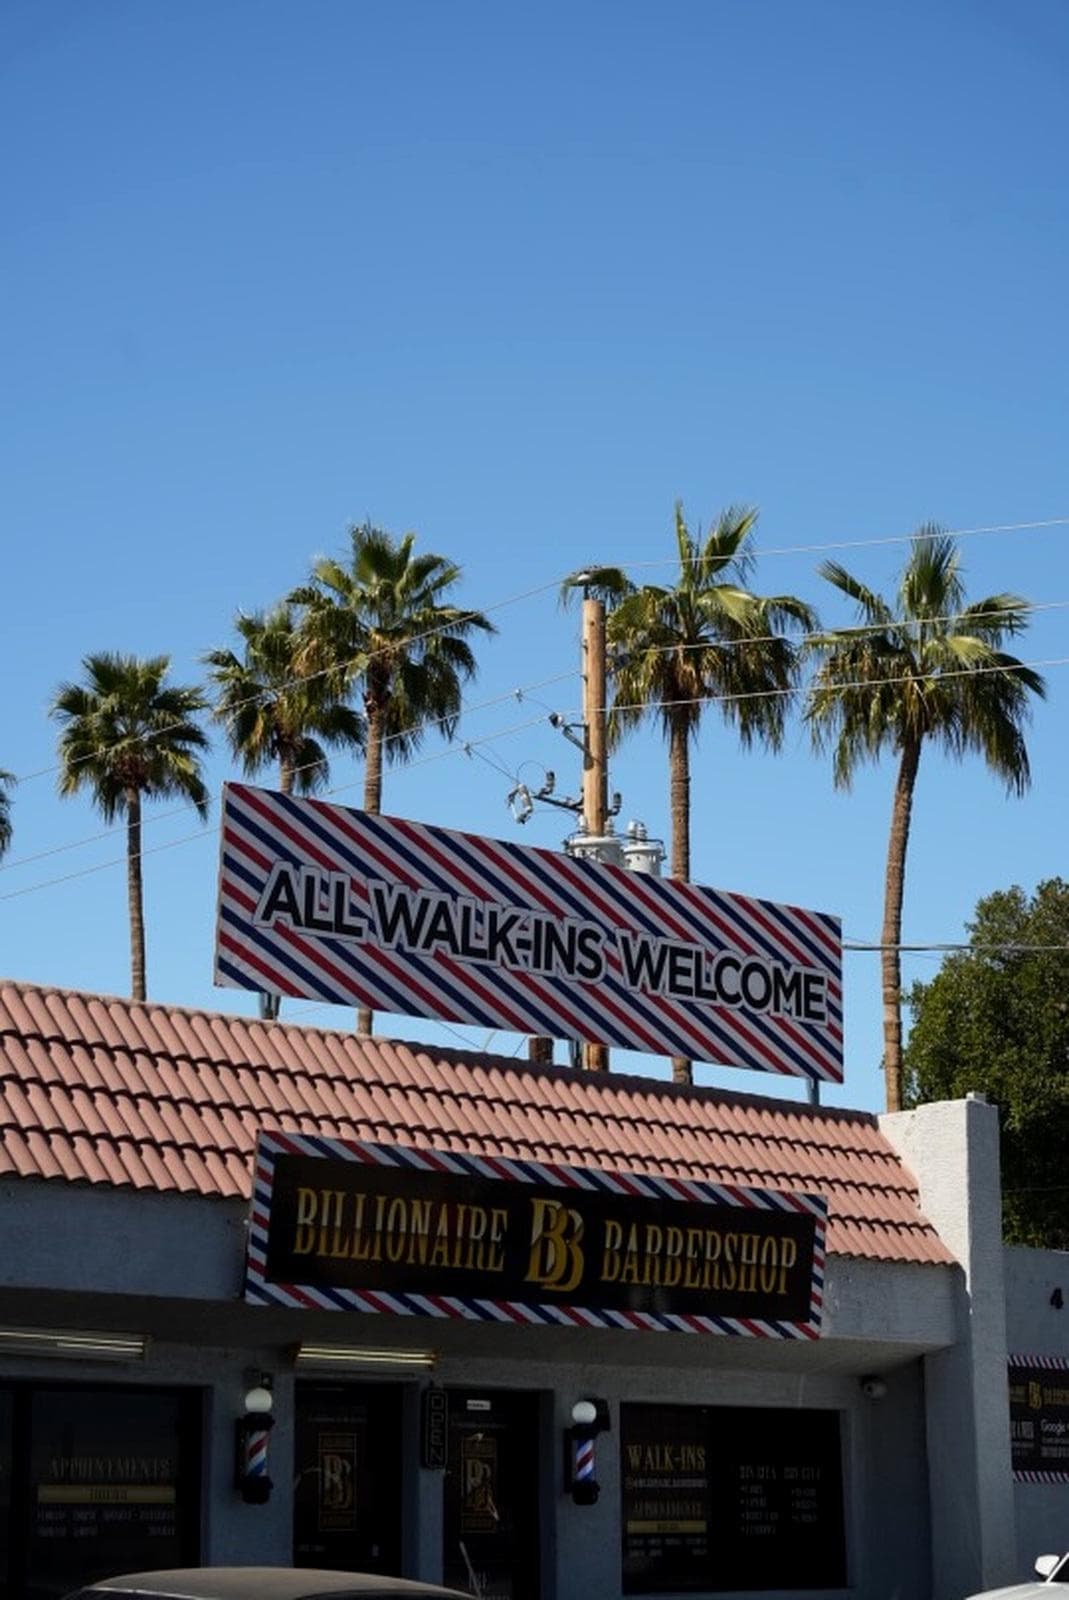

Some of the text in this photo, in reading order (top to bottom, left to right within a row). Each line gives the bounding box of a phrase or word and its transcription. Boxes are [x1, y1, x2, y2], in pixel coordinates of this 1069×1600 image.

[258, 865, 829, 1024] ALL WALK-INS WELCOME
[292, 1186, 509, 1273] BILLIONAIRE
[599, 1218, 798, 1296] BARBERSHOP
[625, 1444, 706, 1471] WALK-INS
